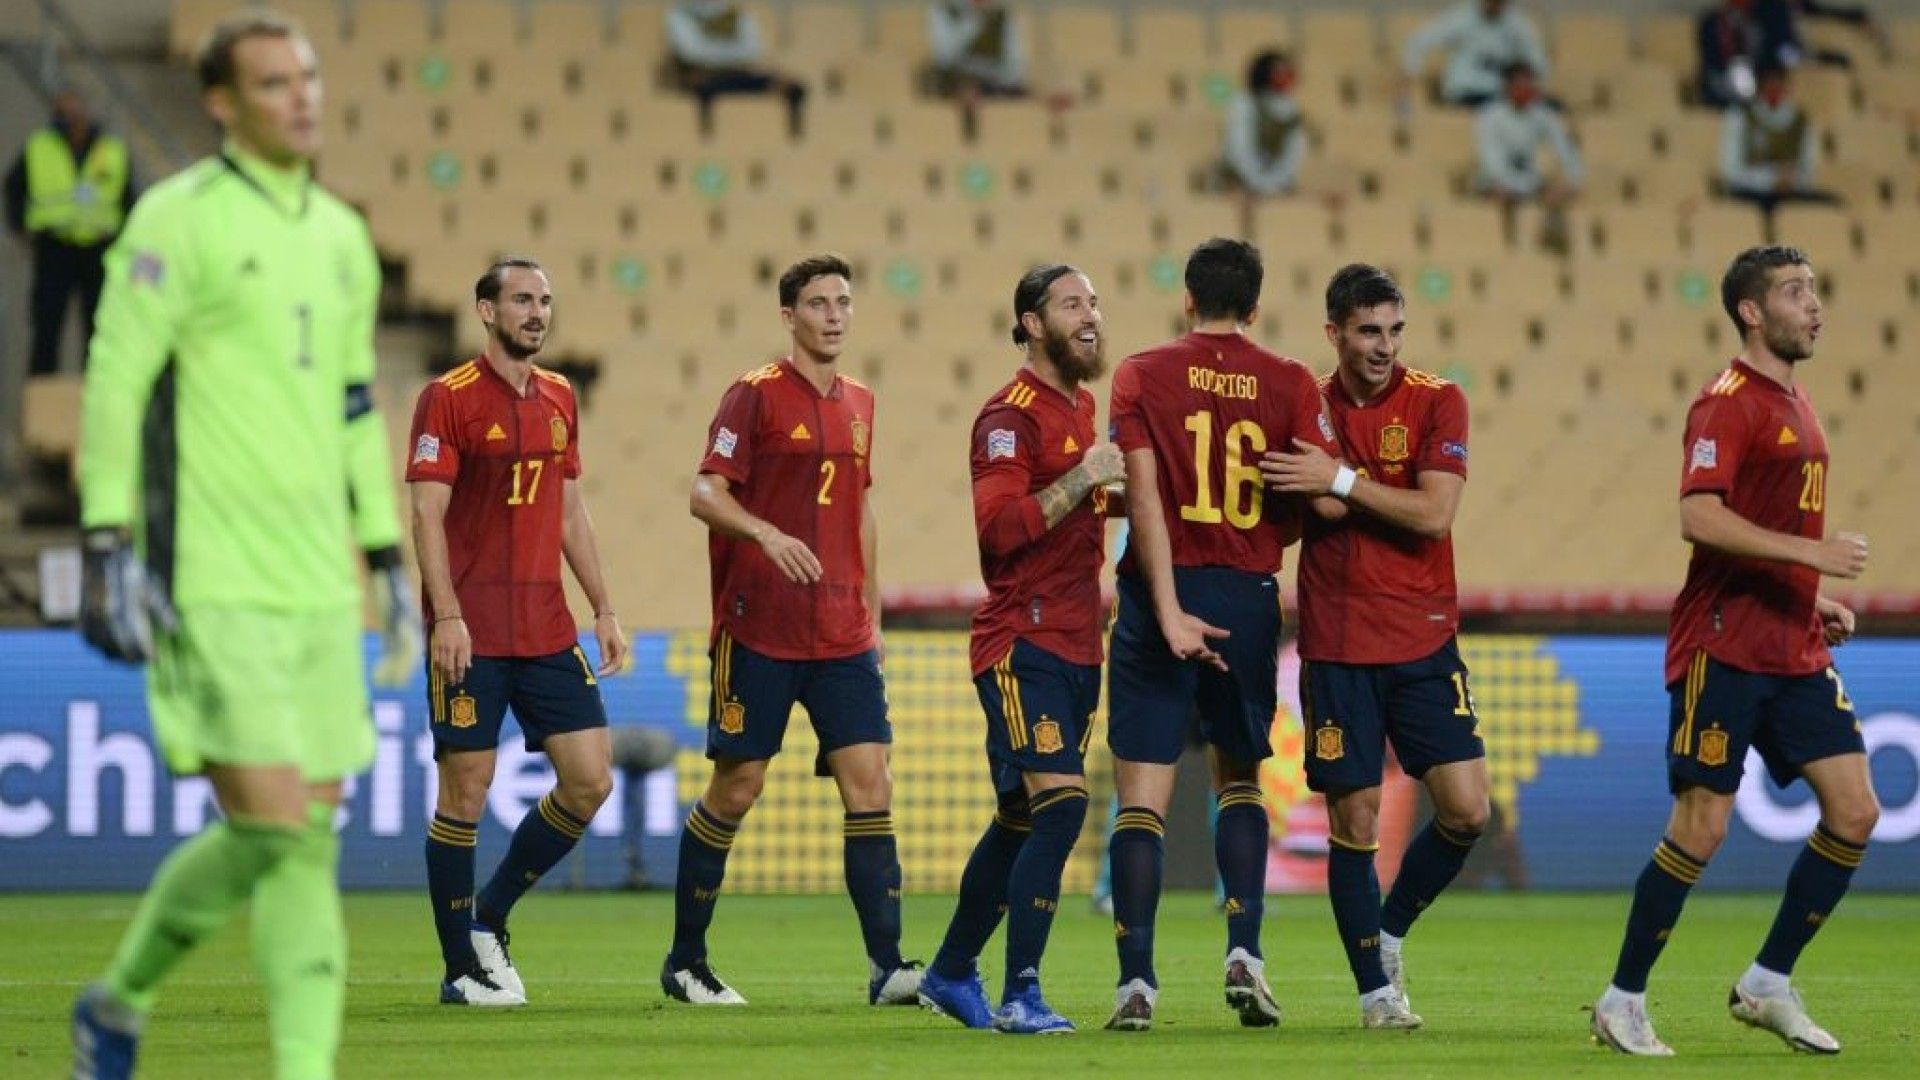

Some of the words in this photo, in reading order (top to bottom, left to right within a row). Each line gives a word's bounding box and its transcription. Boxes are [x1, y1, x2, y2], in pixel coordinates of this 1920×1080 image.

[291, 302, 315, 371] 1
[507, 459, 544, 505] 17
[817, 459, 836, 505] 2
[1180, 409, 1267, 530] 16
[1798, 461, 1825, 512] 20
